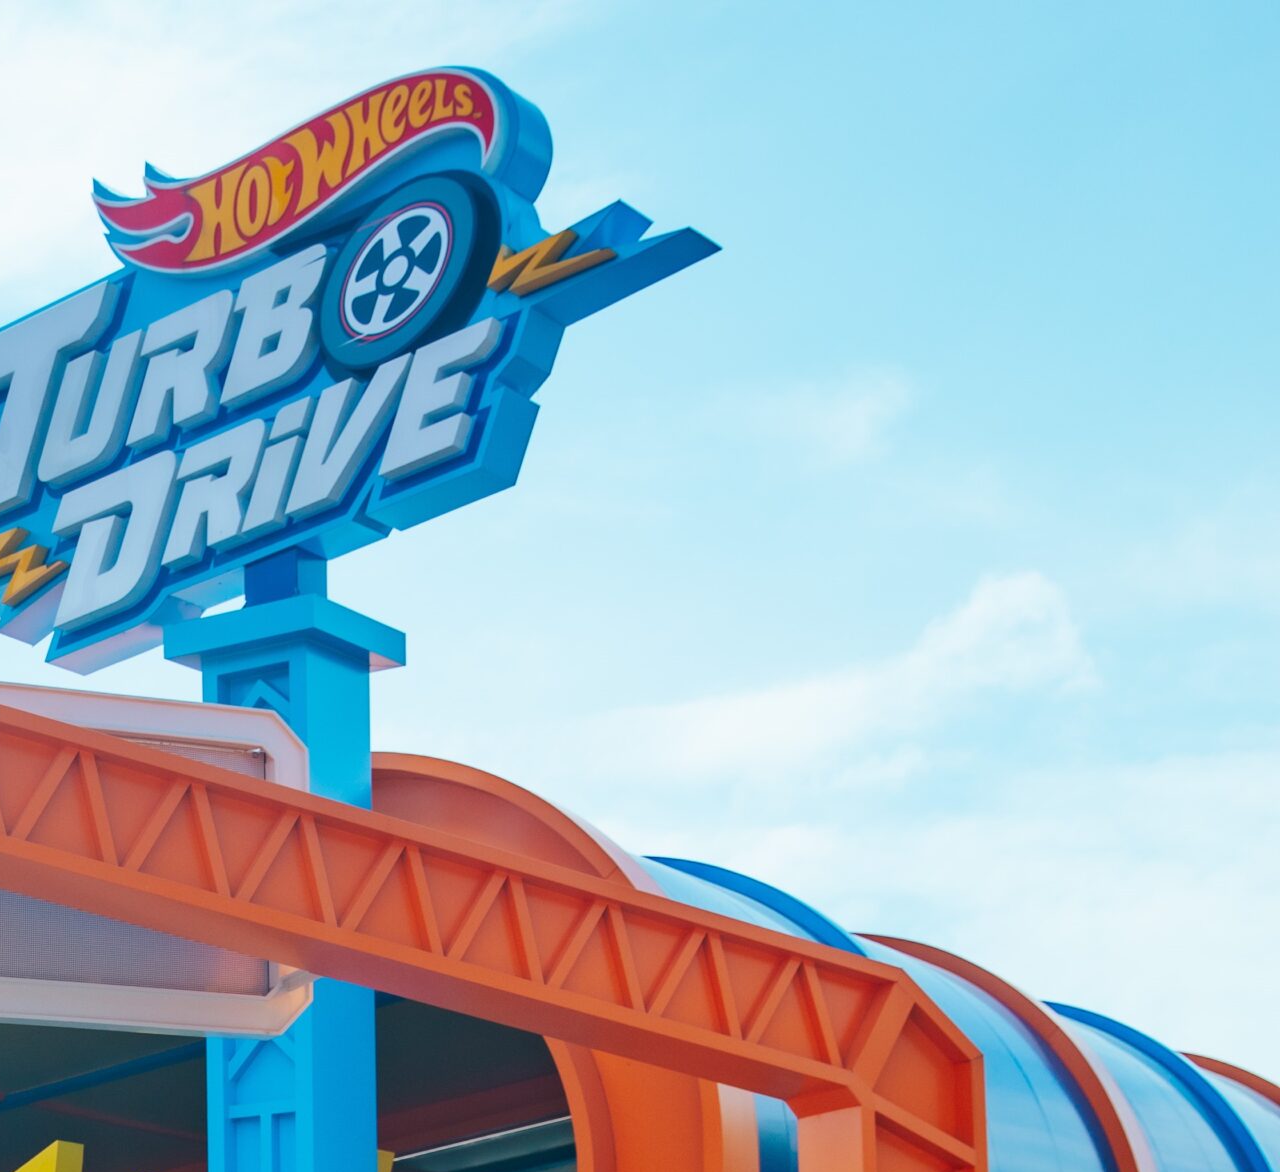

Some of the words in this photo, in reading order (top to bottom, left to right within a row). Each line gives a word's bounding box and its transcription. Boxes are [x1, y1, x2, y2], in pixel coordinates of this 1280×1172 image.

[183, 156, 295, 262] HOT
[283, 80, 474, 217] WHEELS
[51, 317, 498, 634] DRIVE
